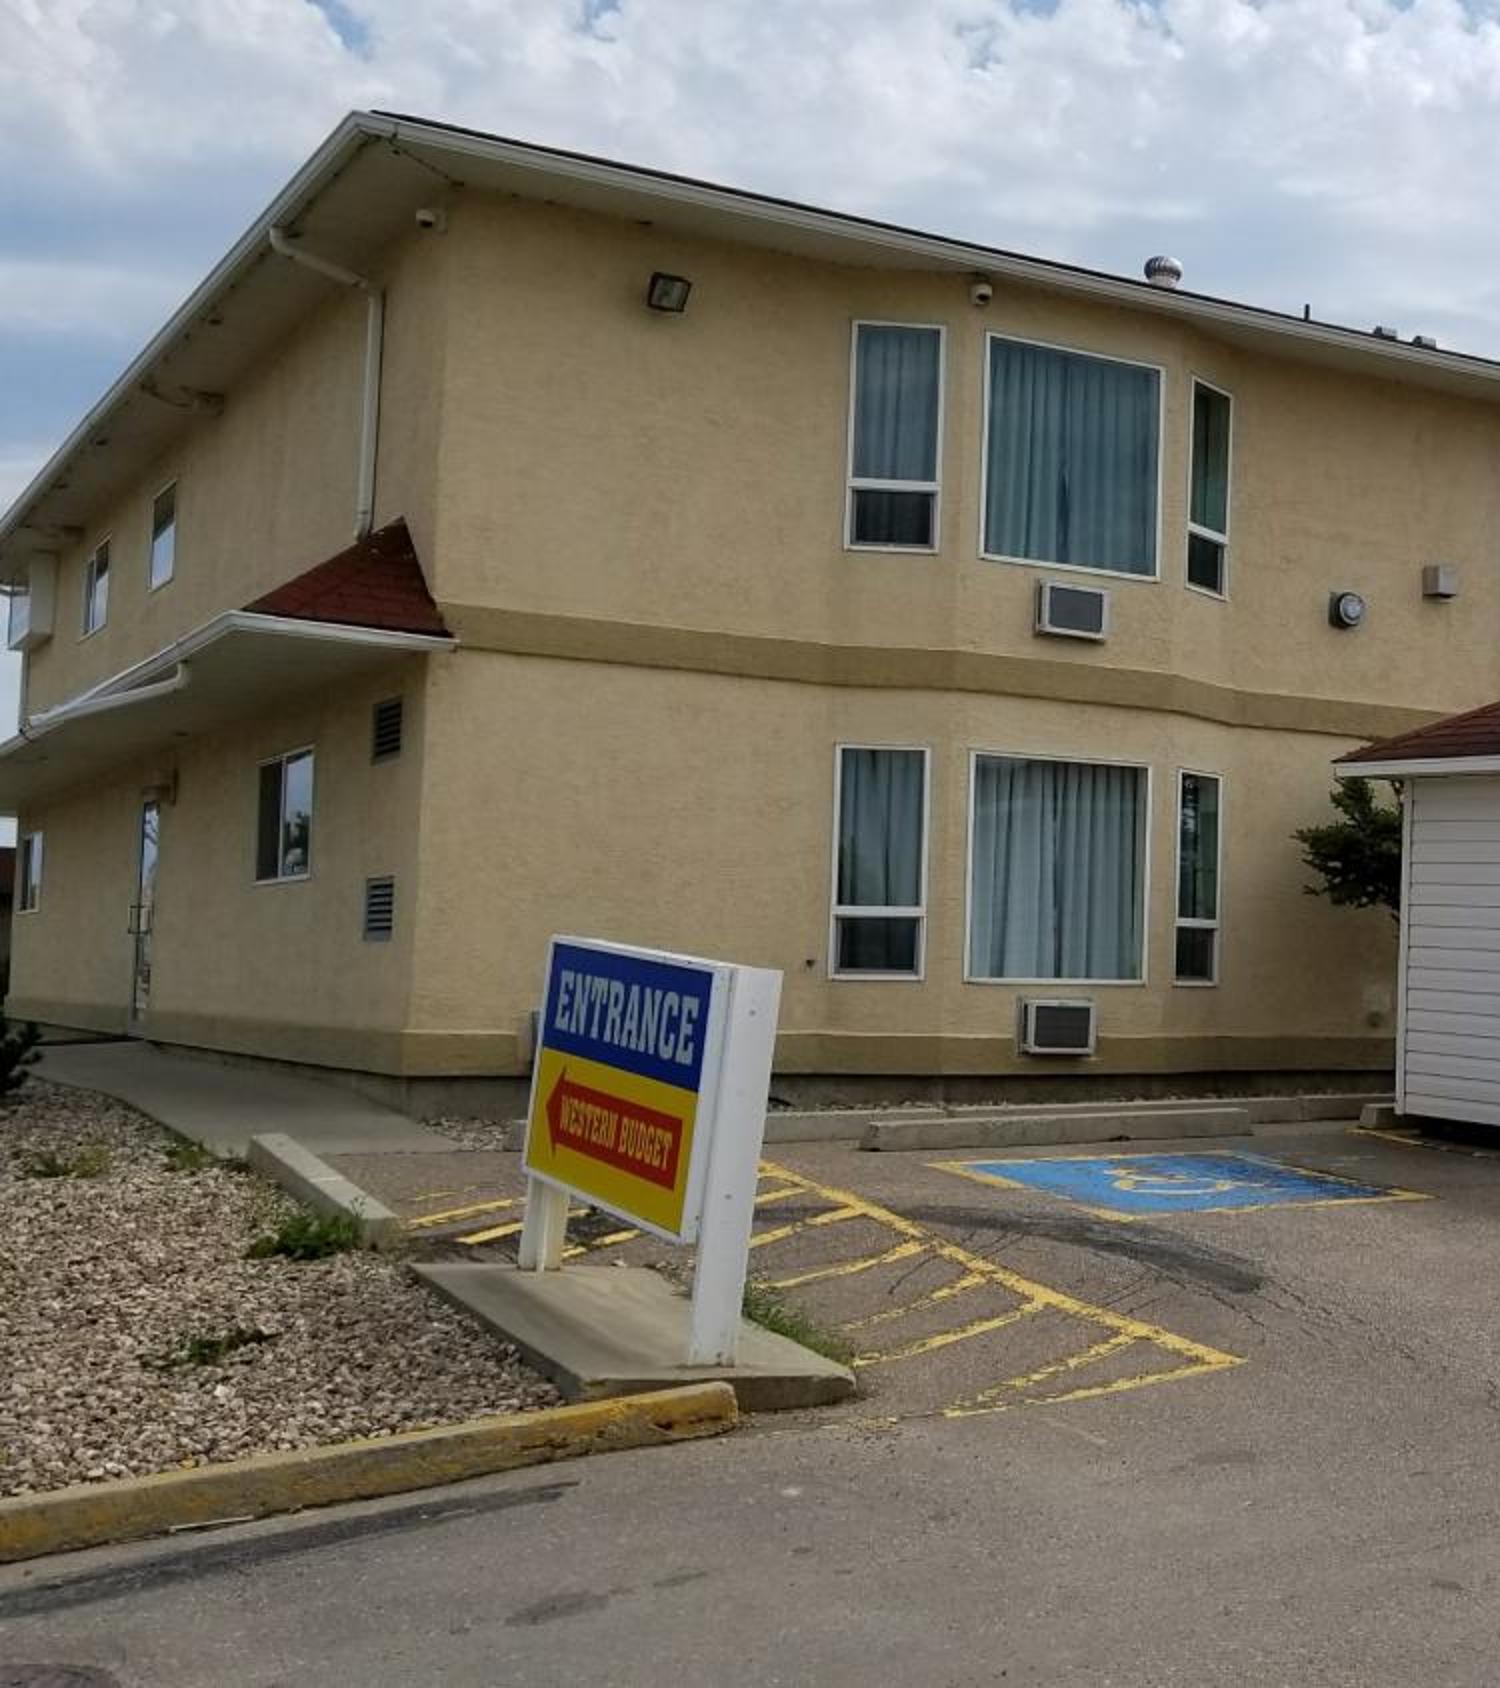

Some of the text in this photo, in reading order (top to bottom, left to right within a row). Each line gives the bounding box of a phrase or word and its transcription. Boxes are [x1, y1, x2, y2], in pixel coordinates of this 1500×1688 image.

[553, 969, 700, 1066] ENTRANCE
[560, 1093, 673, 1172] WESTERN BUDGET
